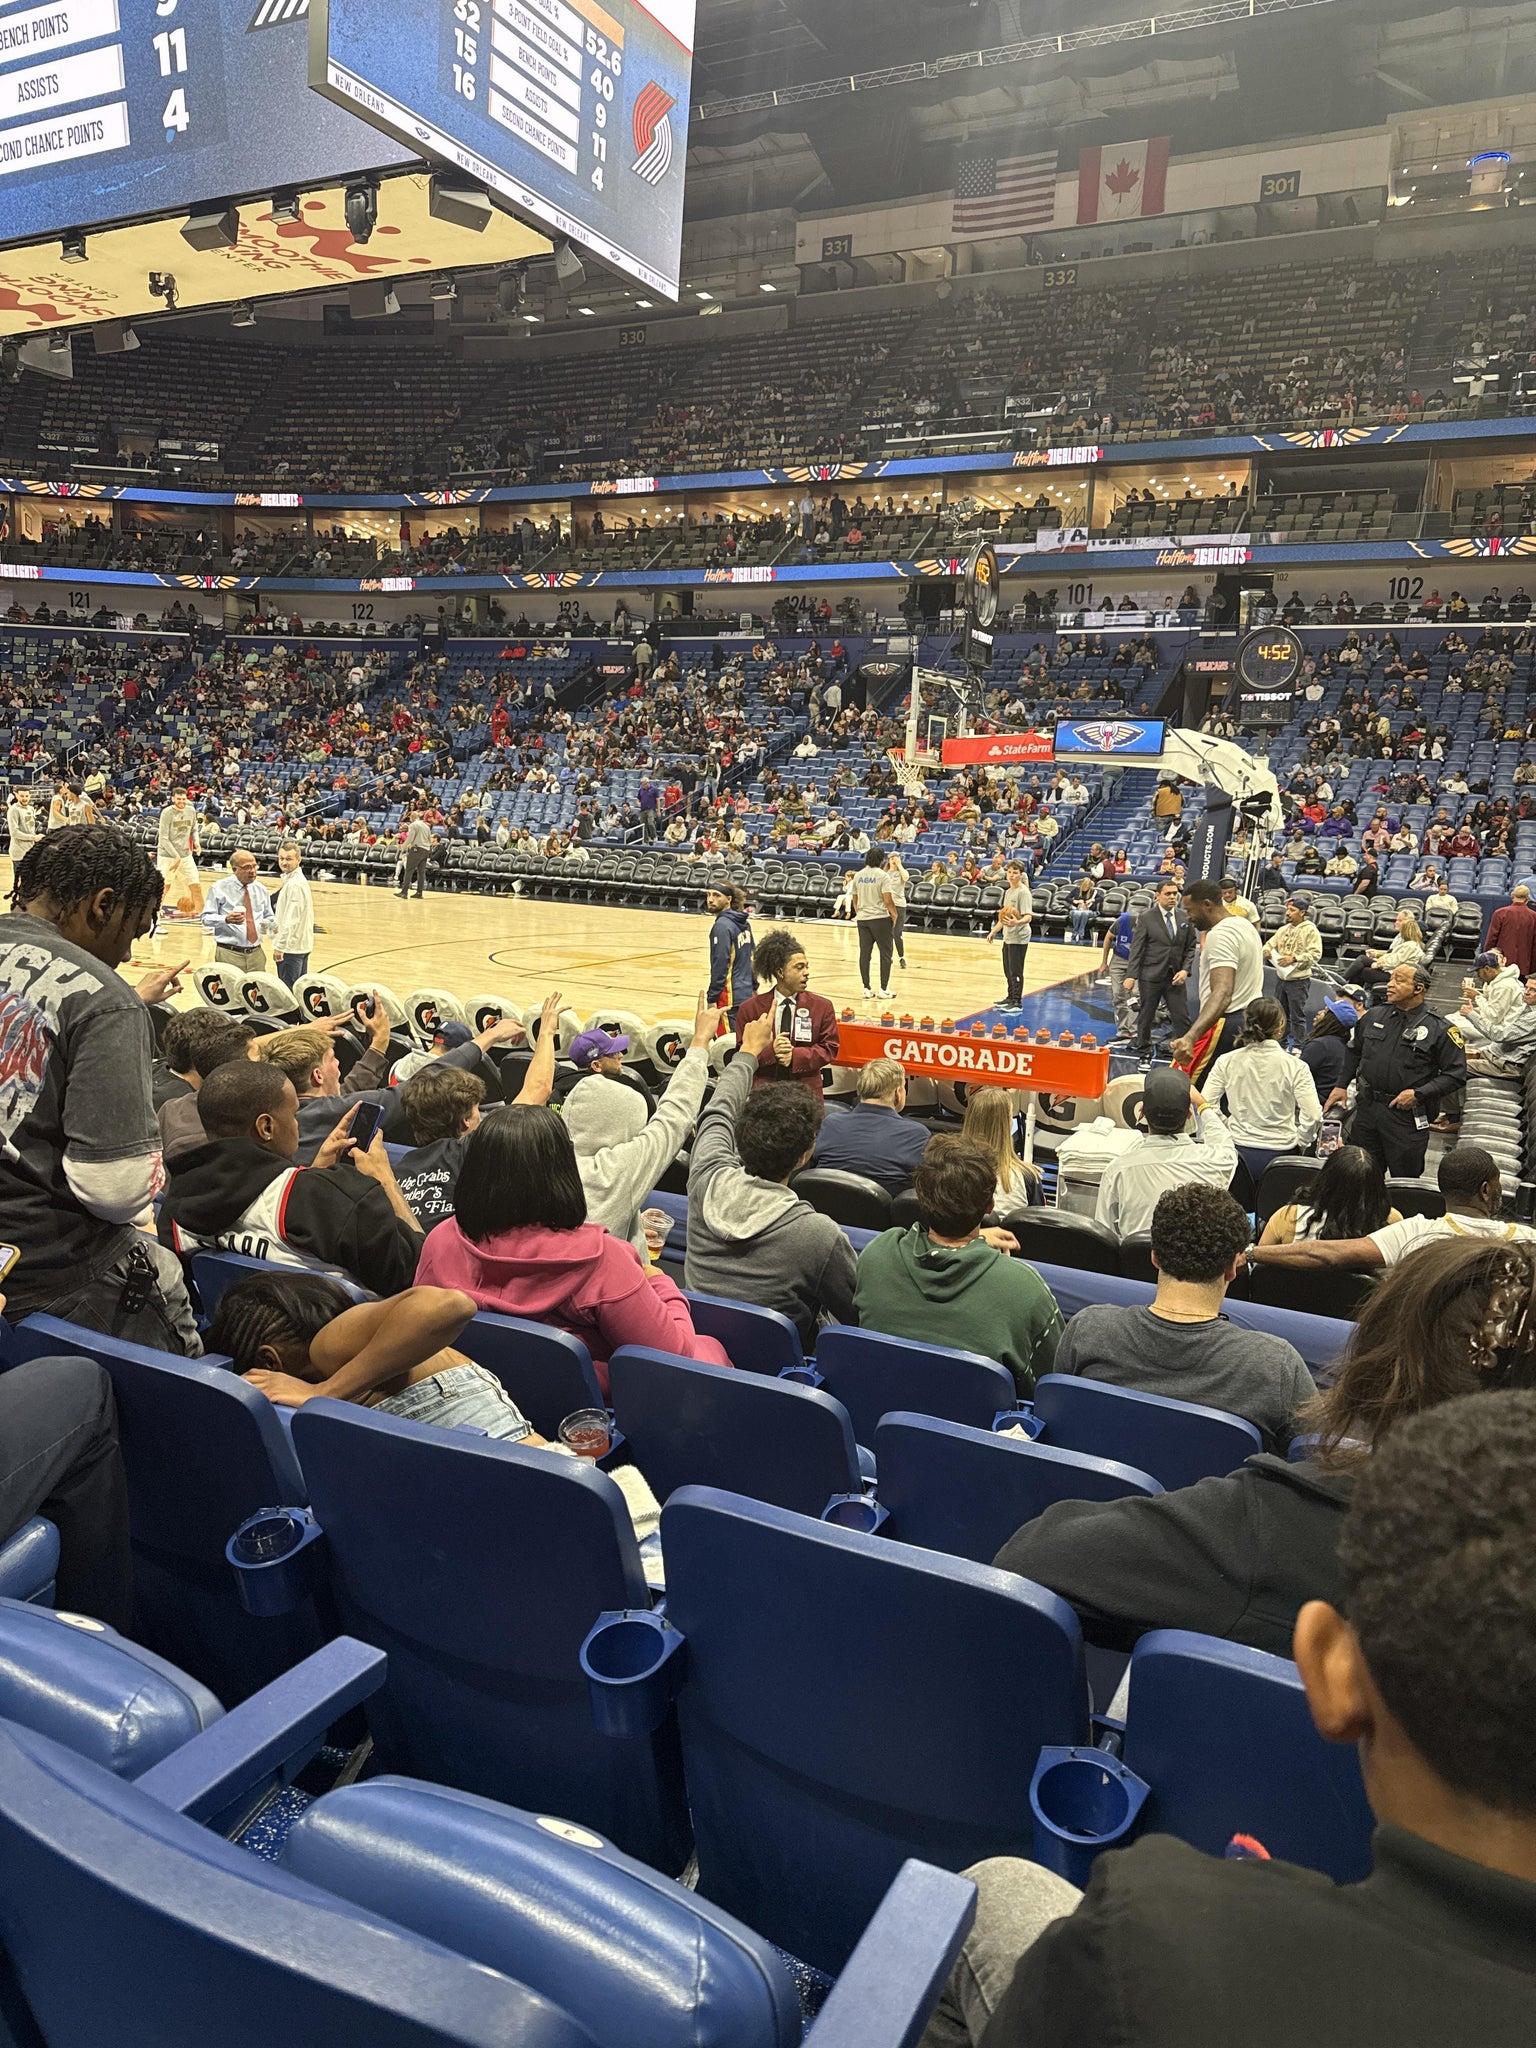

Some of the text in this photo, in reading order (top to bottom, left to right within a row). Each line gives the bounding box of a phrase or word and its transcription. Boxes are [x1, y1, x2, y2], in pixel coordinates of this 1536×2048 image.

[32, 12, 69, 42] POINTS
[508, 3, 569, 62] 3-POINT FIELD GOAL %
[152, 27, 188, 77] 11
[454, 27, 477, 66] 15
[586, 27, 622, 77] 52.6
[518, 46, 557, 87] BENCH POINTS
[18, 73, 59, 103] ASSISTS
[335, 73, 385, 114] NEW ORLEANS
[452, 63, 476, 101] 16
[590, 68, 615, 102] 40
[162, 87, 190, 133] 4
[524, 87, 548, 114] ASSISTS
[595, 102, 607, 128] 9
[24, 129, 64, 157] CHANCE
[68, 119, 104, 147] POINTS
[502, 105, 566, 161] SECOND CHANCE POINTS
[592, 131, 607, 163] 11
[456, 151, 498, 186] NEW ORLEANS
[591, 166, 604, 192] 4
[1264, 177, 1296, 196] 301
[556, 215, 590, 244] NEW ORLEANS
[210, 248, 267, 273] ENTER
[239, 222, 353, 281] MOOTHIE
[824, 239, 849, 256] 331
[28, 274, 109, 303] KING
[49, 272, 119, 300] CENTER
[1044, 269, 1076, 287] 332
[620, 330, 645, 346] 330
[0, 564, 39, 579] IGHLIGHTS
[1204, 575, 1215, 584] 101
[1276, 573, 1289, 582] 102
[68, 591, 90, 608] 121
[1068, 583, 1094, 605] 101
[1388, 577, 1424, 600] 102
[352, 603, 374, 620] 122
[1258, 644, 1291, 660] 4:52
[1254, 693, 1292, 701] TISSOT
[202, 974, 230, 1006] G
[242, 981, 270, 1013] G
[303, 986, 331, 1017] G
[415, 1001, 441, 1033] G
[656, 1033, 687, 1067] G
[884, 1038, 1033, 1077] GATORADE
[401, 1168, 451, 1190] the Crabs
[404, 1186, 443, 1201] ntley's
[424, 1200, 456, 1214] Fla.
